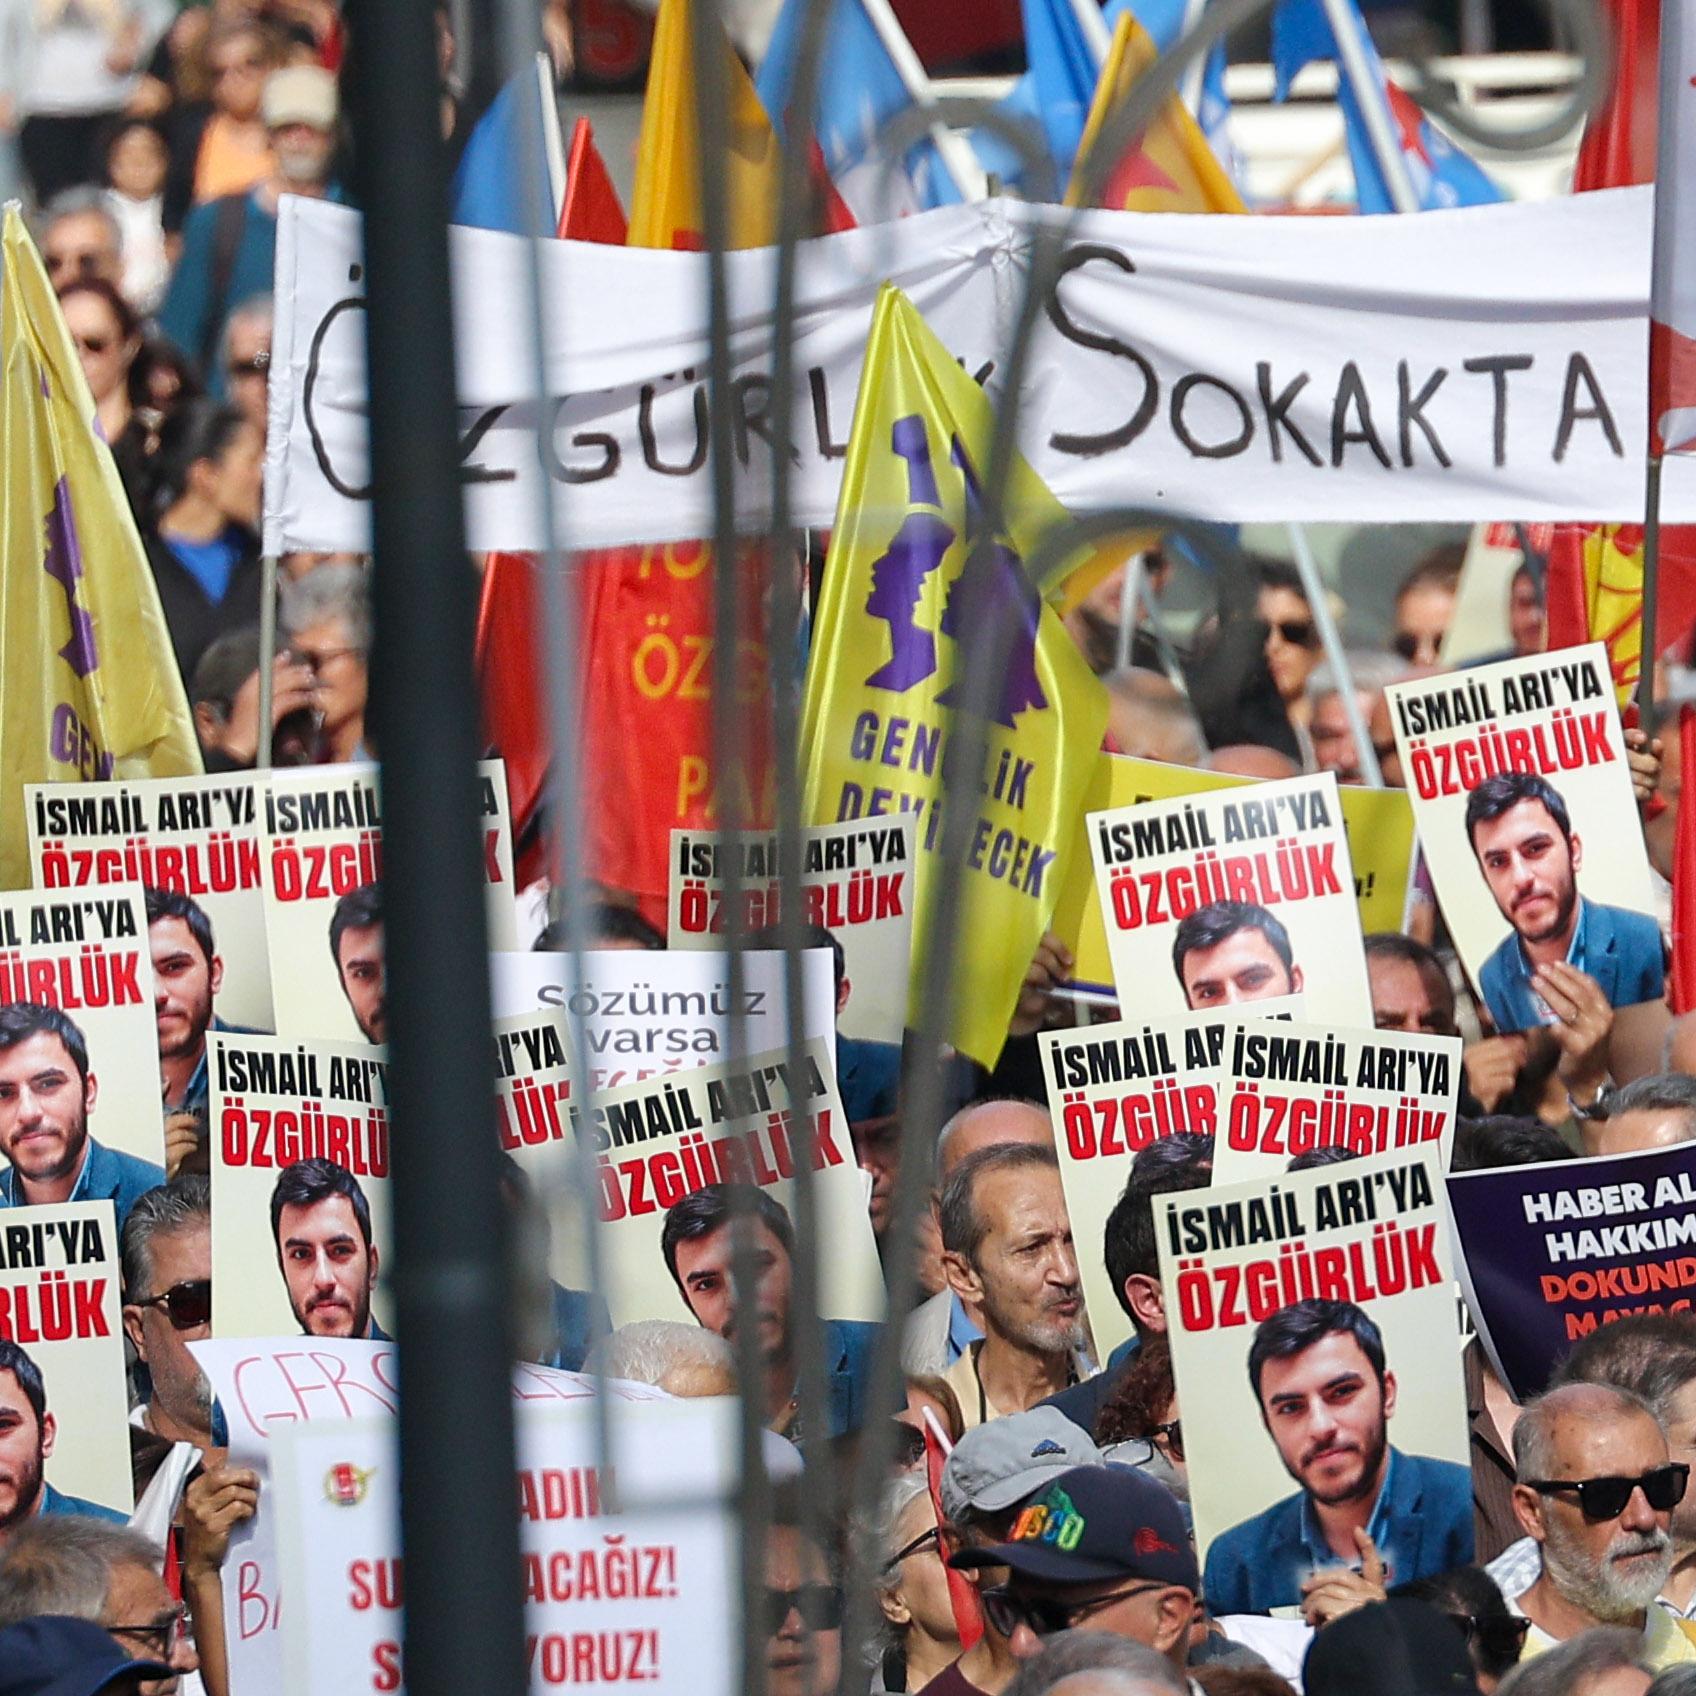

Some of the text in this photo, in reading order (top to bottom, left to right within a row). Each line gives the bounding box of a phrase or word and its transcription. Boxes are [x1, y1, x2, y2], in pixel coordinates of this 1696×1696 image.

[1046, 245, 1624, 468] SOKAKTA
[1396, 677, 1497, 737] İSMAİL
[1410, 707, 1617, 800] ÖZGÜRLÜK
[36, 788, 149, 836] İSMAİL
[265, 780, 382, 835] İSMAİL
[1098, 804, 1216, 865] İSMAİL
[1109, 837, 1343, 931] ÖZGÜRLÜK
[217, 1041, 322, 1097] İSMAİL
[585, 1027, 720, 1054] varsa
[1051, 1026, 1176, 1090] İSMAİL
[1231, 1026, 1348, 1087] İSMAİL
[221, 1096, 390, 1179] ÖZGÜRLÜ
[1063, 1079, 1217, 1161] ÖZGÜR
[1167, 1185, 1306, 1256] İSMAİL
[1522, 1180, 1648, 1224] HABER
[1177, 1220, 1443, 1332] ÖZGÜRLÜK
